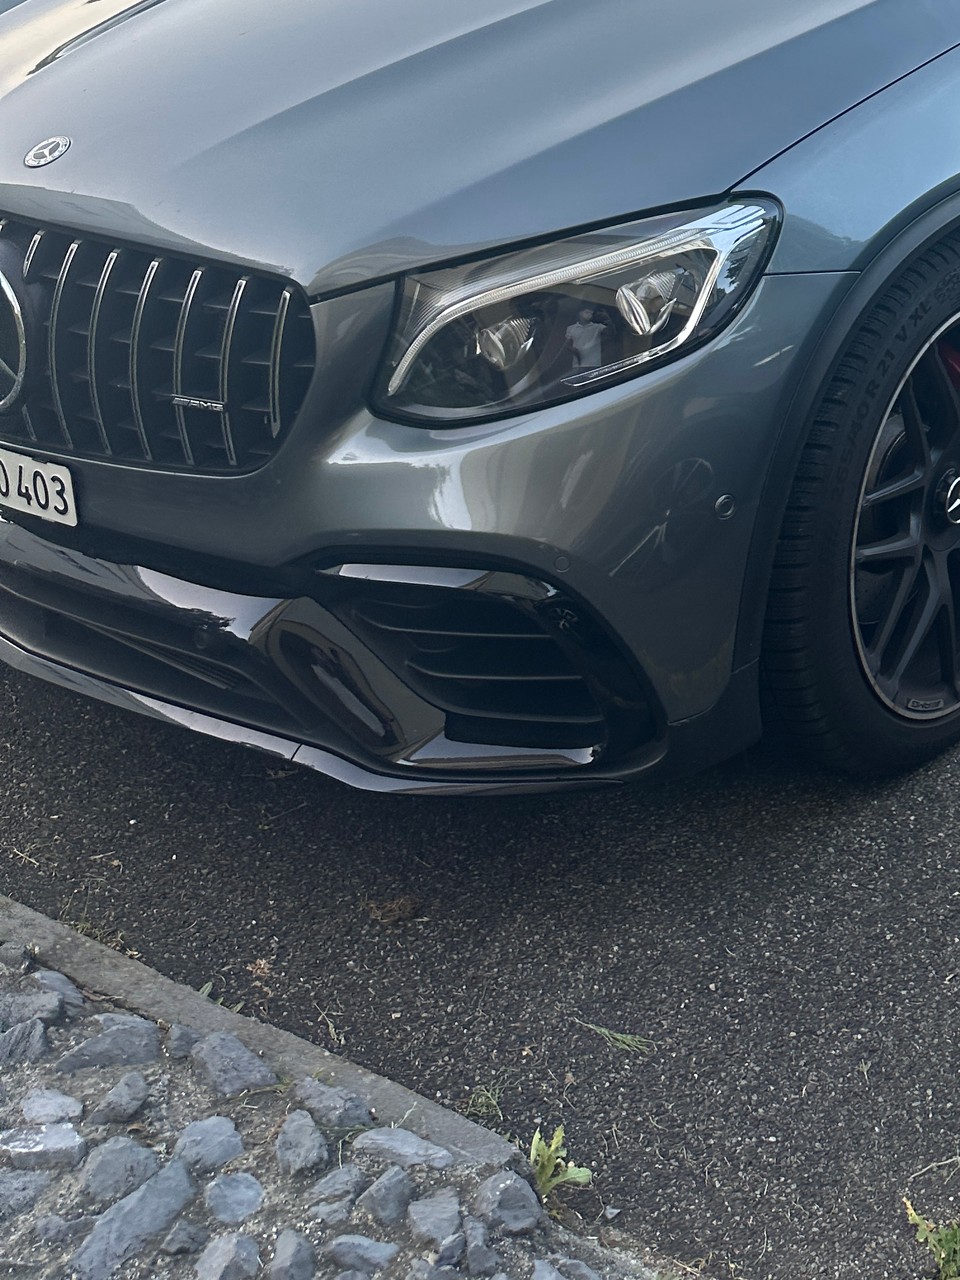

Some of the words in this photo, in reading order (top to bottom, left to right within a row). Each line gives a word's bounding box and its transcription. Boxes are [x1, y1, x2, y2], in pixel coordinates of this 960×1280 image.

[866, 378, 881, 399] R
[877, 349, 895, 377] 21
[895, 325, 908, 342] V
[909, 301, 932, 327] XL
[187, 399, 223, 412] AMG
[17, 464, 69, 516] 403
